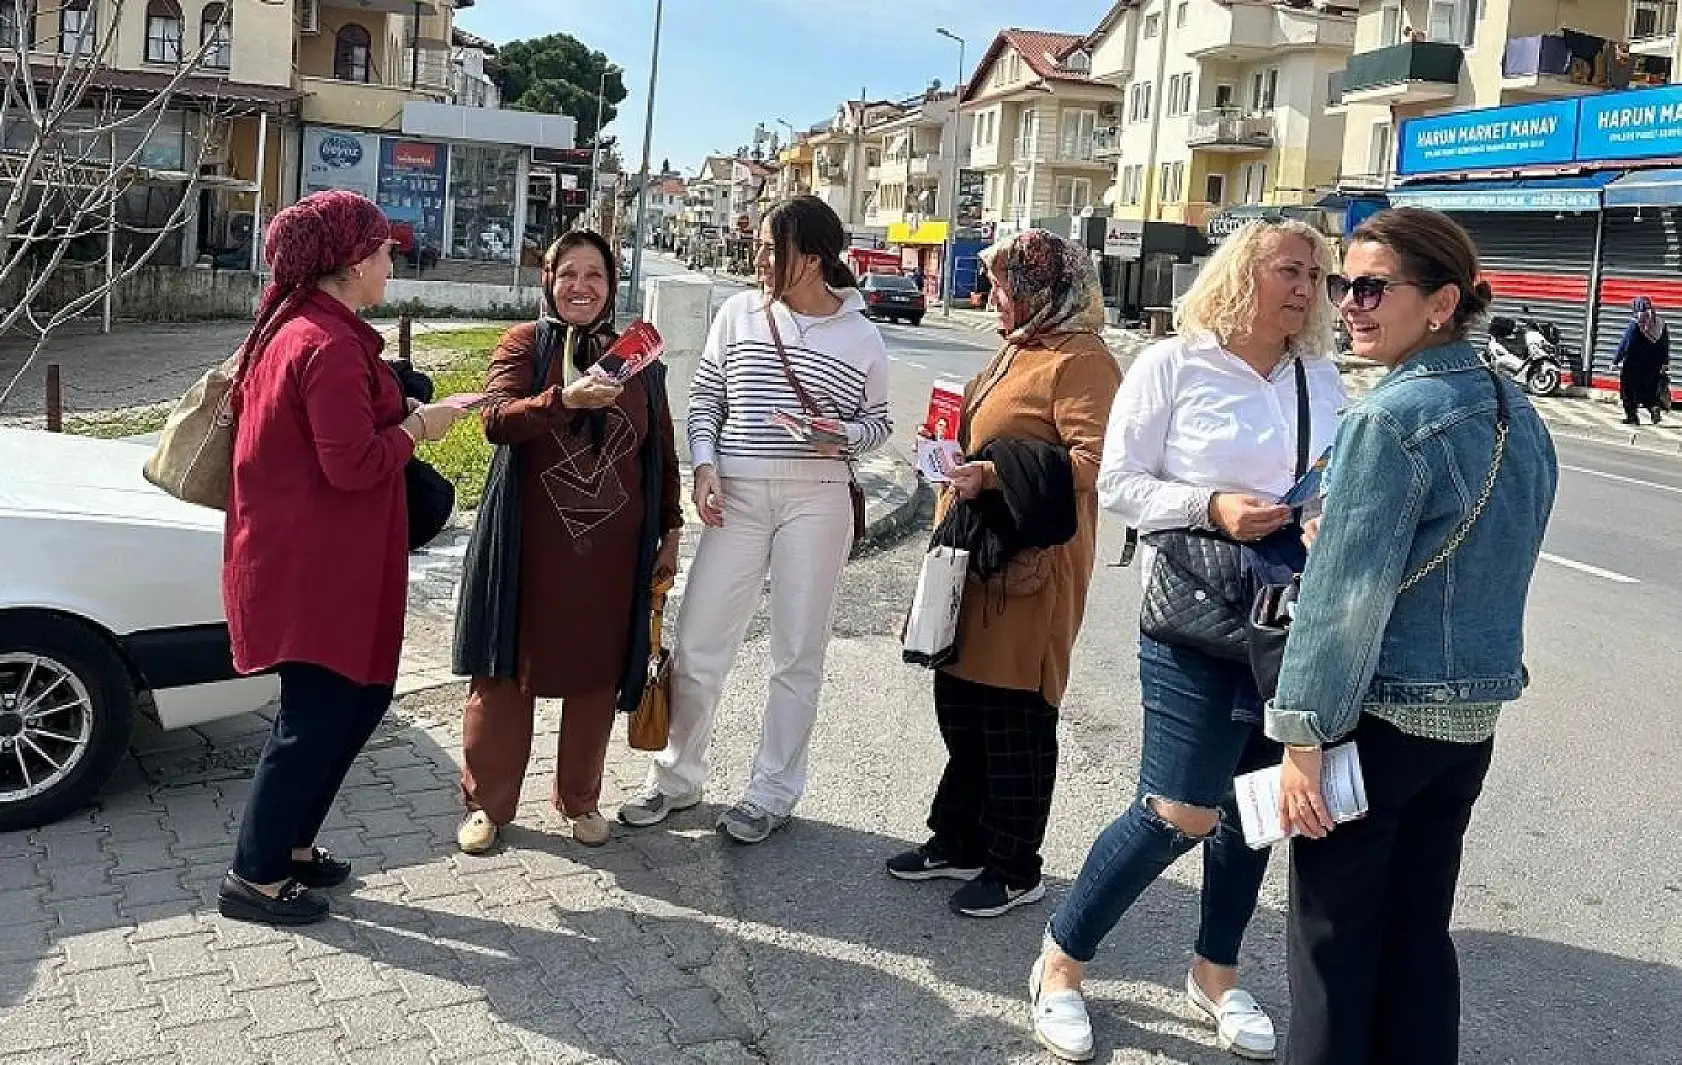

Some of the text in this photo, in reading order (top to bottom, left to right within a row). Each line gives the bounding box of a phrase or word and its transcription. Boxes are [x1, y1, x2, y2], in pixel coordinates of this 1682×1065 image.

[1417, 116, 1557, 147] HARUN MARKET MANAV
[1599, 106, 1656, 130] HARUN
